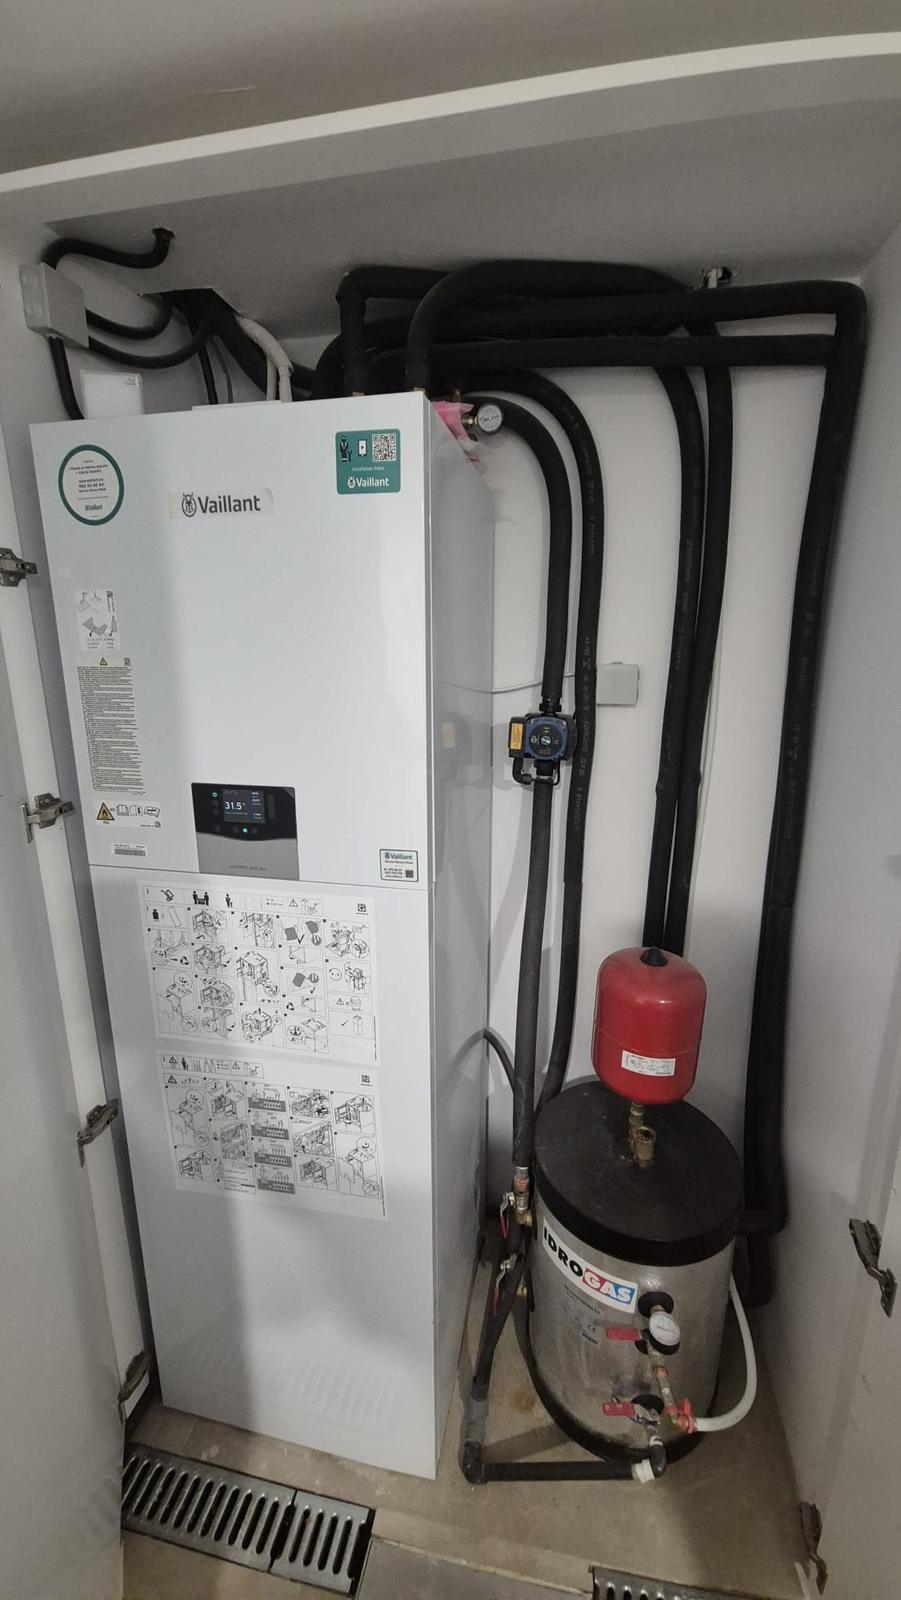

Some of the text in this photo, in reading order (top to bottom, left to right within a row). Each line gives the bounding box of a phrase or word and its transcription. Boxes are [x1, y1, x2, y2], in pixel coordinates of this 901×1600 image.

[355, 476, 390, 487] Vaillant
[197, 494, 262, 514] Vaillant
[390, 852, 413, 860] Vaillant
[543, 1226, 636, 1305] IDROGAS
